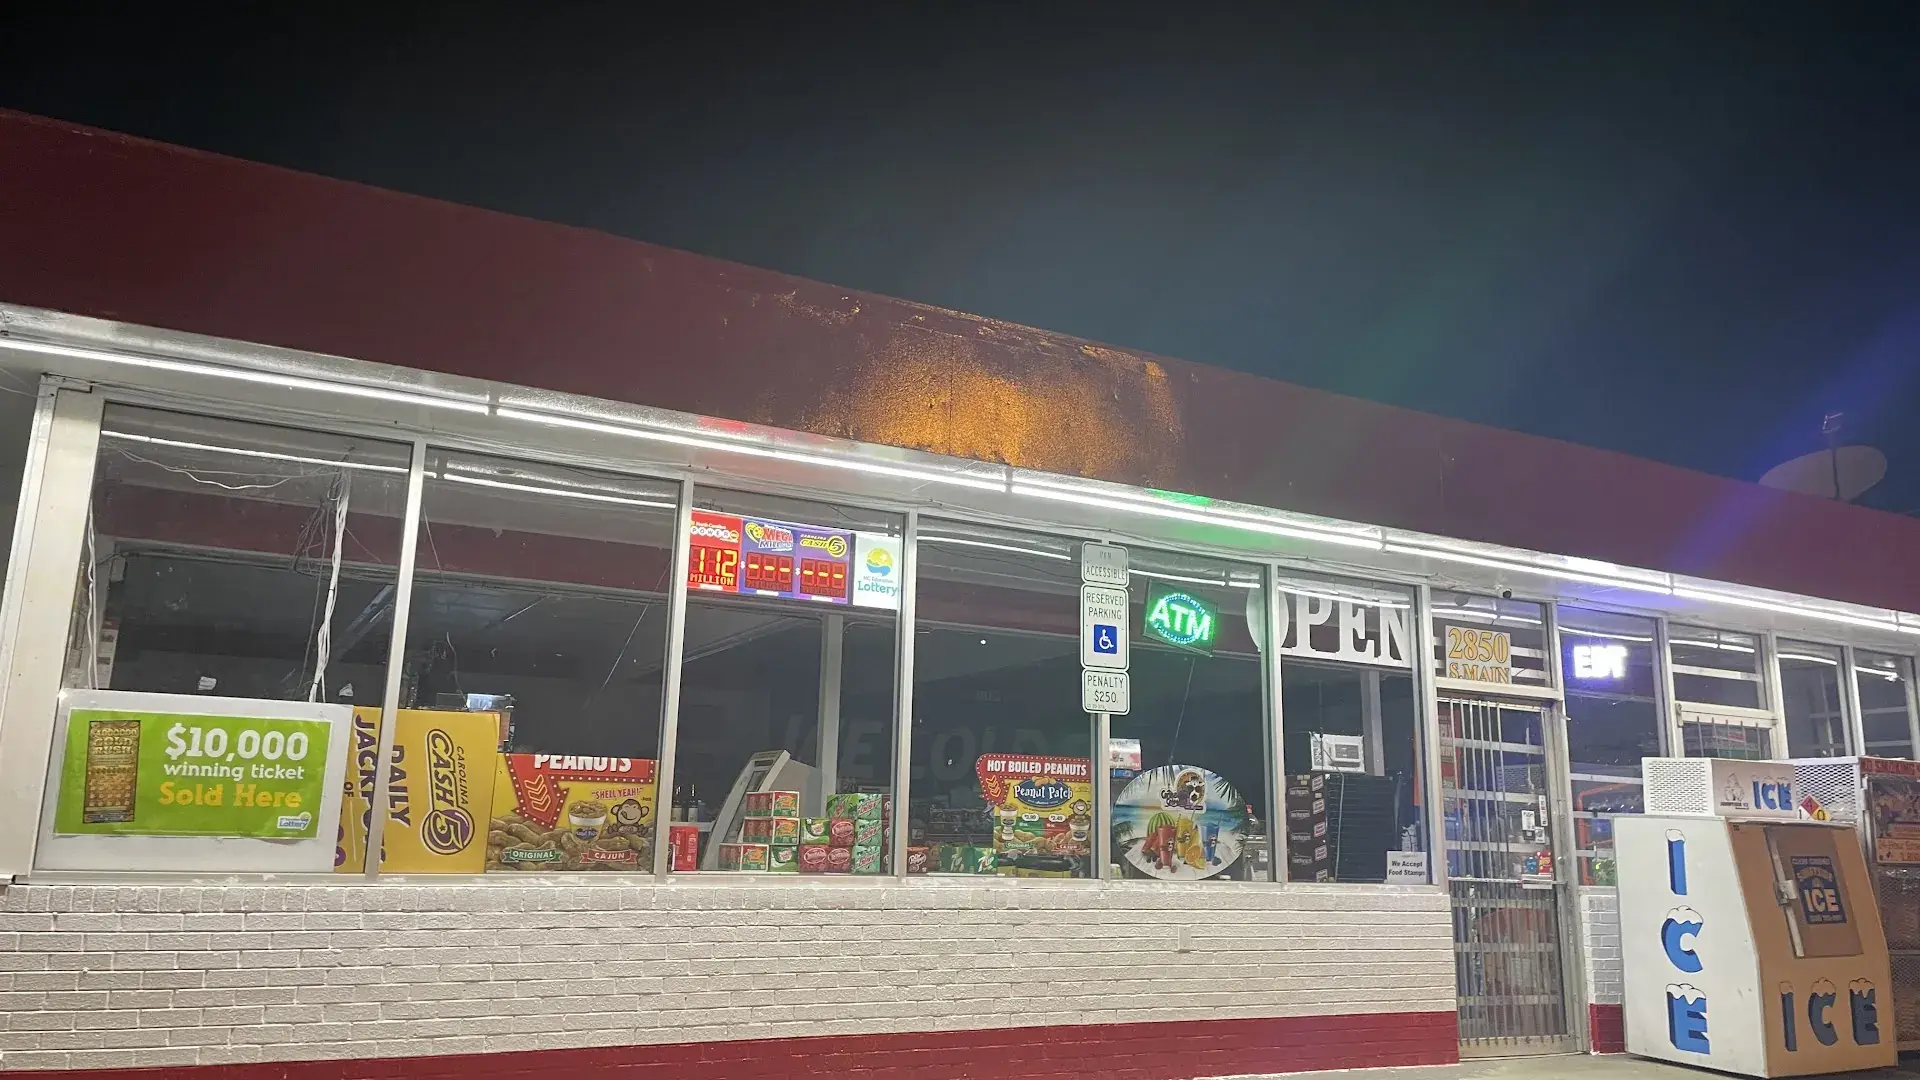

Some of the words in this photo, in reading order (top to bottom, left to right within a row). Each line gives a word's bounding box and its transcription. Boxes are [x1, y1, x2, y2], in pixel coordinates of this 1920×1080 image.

[763, 527, 794, 543] MEGA
[801, 538, 827, 549] CASH
[698, 547, 738, 578] 112
[689, 573, 734, 586] MILLION
[1086, 564, 1126, 580] ACCESSIBLE
[857, 580, 899, 597] Lottery
[1086, 592, 1124, 607] RESERVED
[1088, 607, 1122, 620] PARKING
[1149, 598, 1212, 641] ATM
[1246, 584, 1413, 668] OPEN
[1448, 627, 1510, 664] 2850
[1087, 674, 1124, 688] PENALTY
[1094, 690, 1117, 703] $250
[93, 736, 133, 746] GOLD
[163, 722, 310, 762] $10,000
[430, 732, 455, 808] CASH
[534, 754, 632, 773] PEANUTS
[986, 759, 1006, 772] HOT
[1008, 761, 1042, 775] BOILED
[1043, 762, 1087, 777] PEANUTS
[163, 763, 245, 782] winning
[250, 764, 305, 780] ticket
[456, 745, 469, 805] CAROLINA
[343, 781, 355, 798] OF
[389, 744, 412, 828] DAILY
[1013, 784, 1046, 799] Peanut
[1048, 786, 1073, 800] Patch
[1751, 775, 1793, 811] ICE
[158, 781, 223, 807] Sold
[232, 783, 302, 809] Here
[512, 850, 555, 861] ORIGINAL
[594, 852, 626, 860] CAJUN
[1401, 860, 1423, 868] Accept
[1403, 869, 1426, 877] Stamps
[1803, 888, 1840, 912] ICE
[1660, 828, 1711, 1055] ICE
[1778, 976, 1881, 1052] ICE
